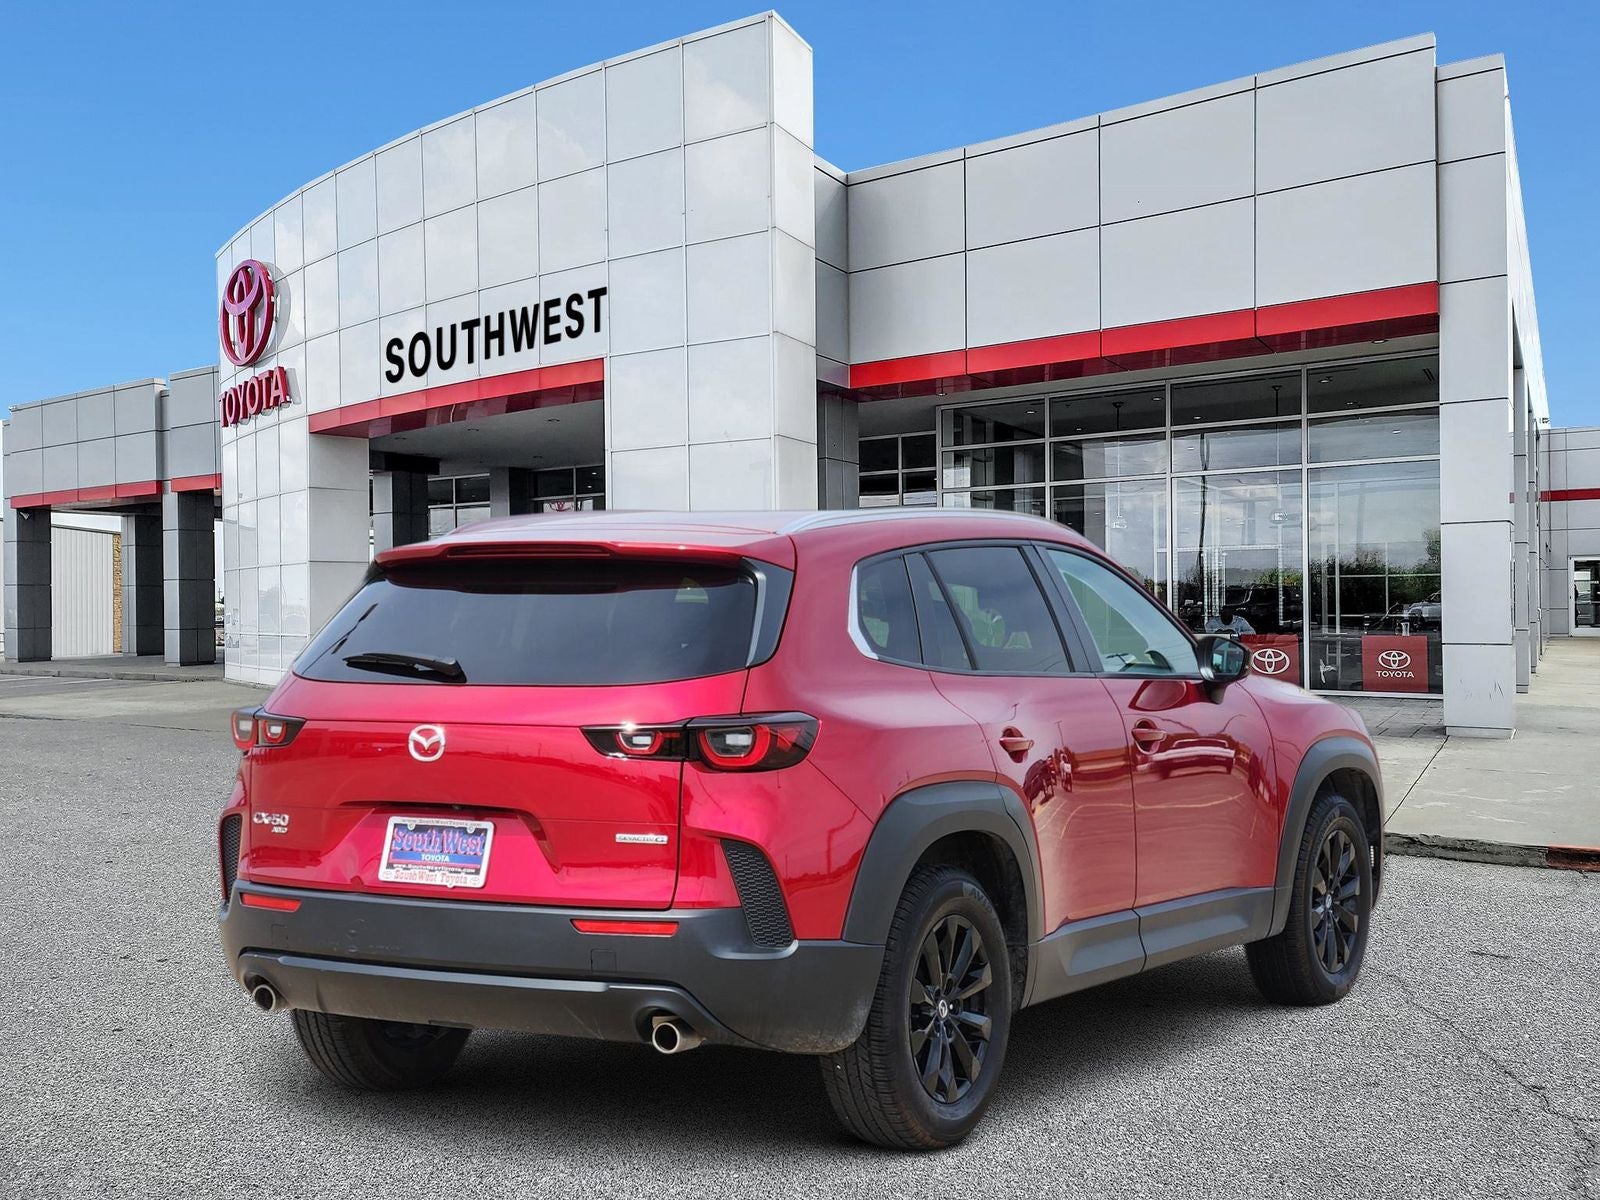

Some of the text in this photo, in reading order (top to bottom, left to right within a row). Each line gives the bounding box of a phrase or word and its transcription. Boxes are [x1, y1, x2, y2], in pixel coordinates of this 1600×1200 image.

[385, 286, 607, 384] SOUTHWEST
[218, 366, 288, 428] TOYOTA
[1376, 670, 1414, 678] TOYOTA
[421, 854, 450, 862] TOYOTA
[440, 872, 467, 885] Toyota
